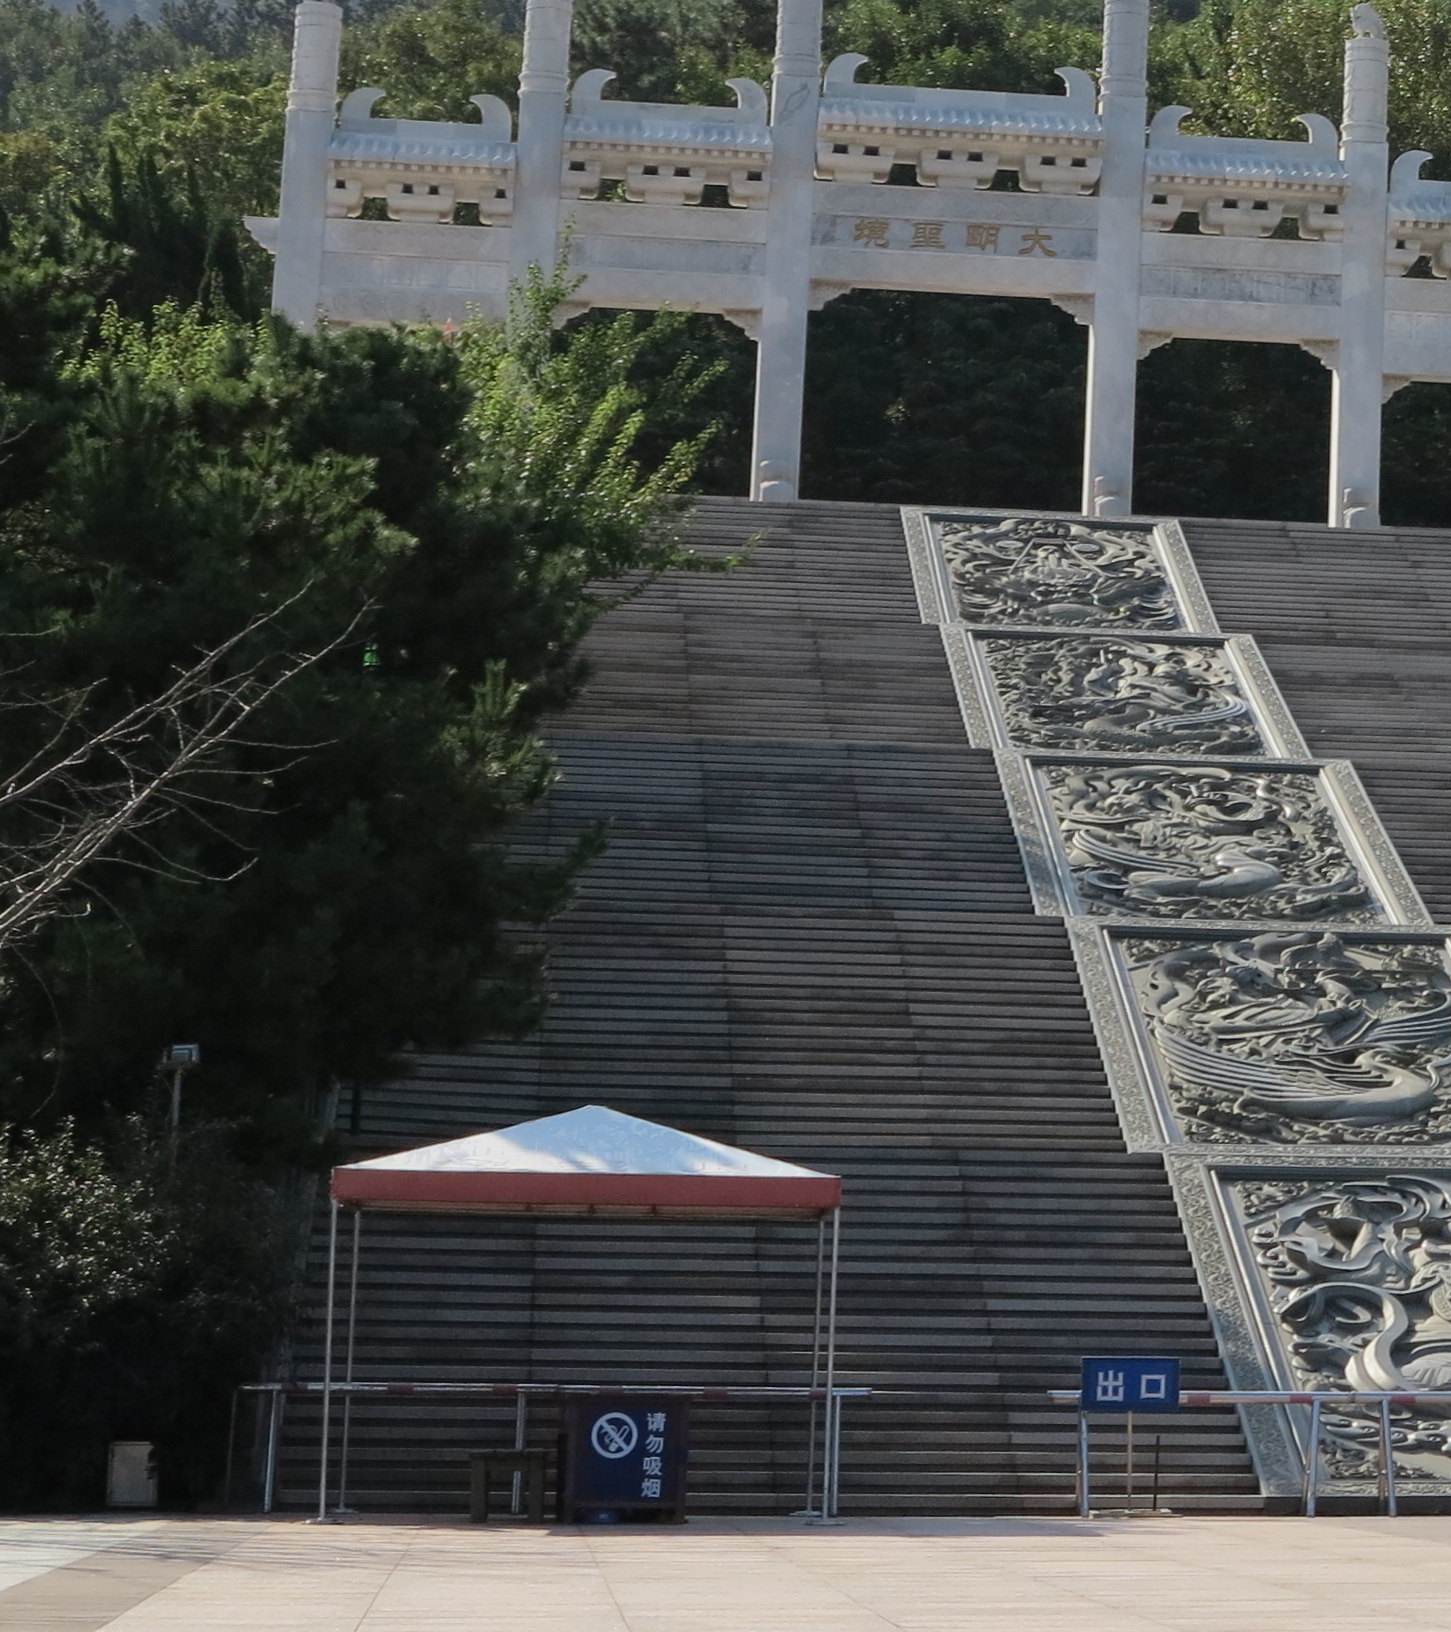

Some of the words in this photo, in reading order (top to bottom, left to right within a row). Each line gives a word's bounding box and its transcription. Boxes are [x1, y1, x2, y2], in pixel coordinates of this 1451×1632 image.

[1096, 1370, 1167, 1402] 出口
[640, 1412, 667, 1499] 请勿吸烟
